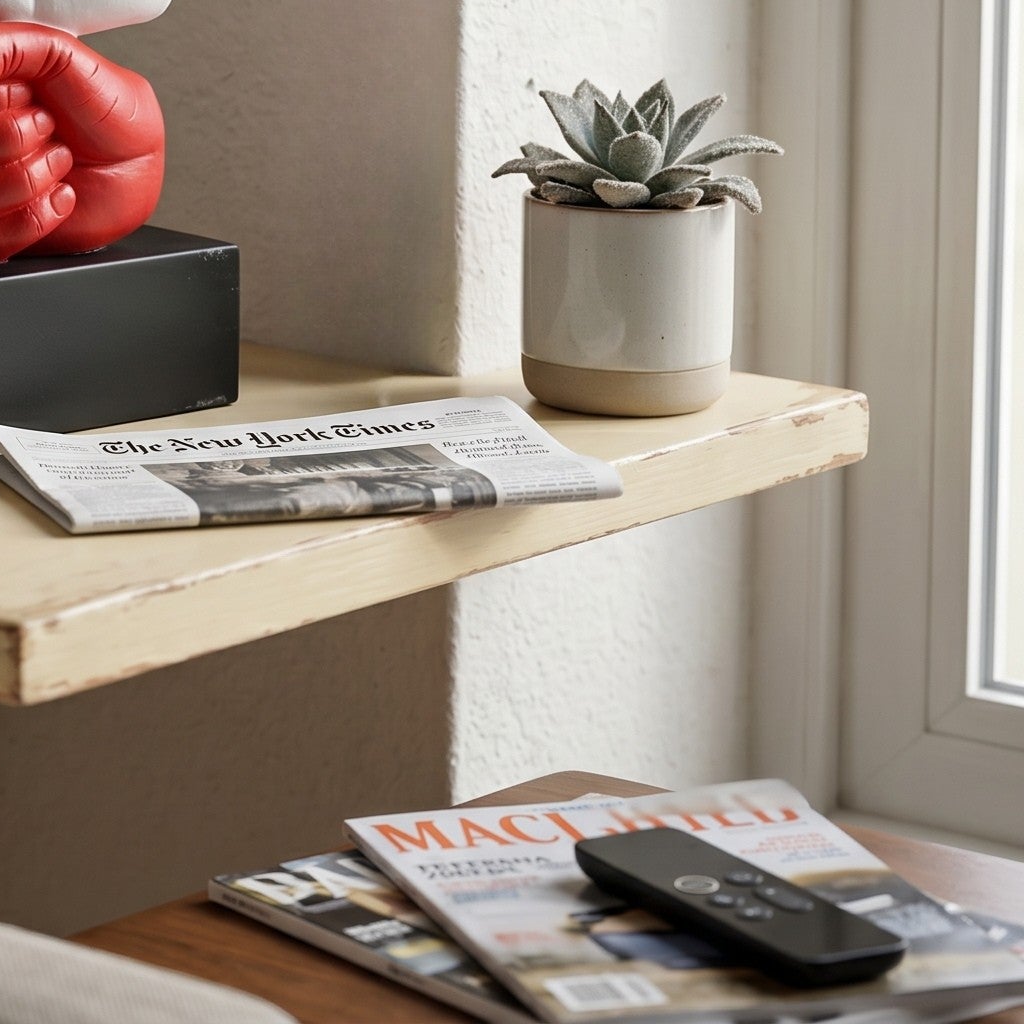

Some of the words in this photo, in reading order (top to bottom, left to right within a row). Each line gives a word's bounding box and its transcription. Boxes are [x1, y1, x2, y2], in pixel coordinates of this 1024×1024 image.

[99, 440, 164, 456] The
[167, 437, 242, 453] New
[246, 427, 329, 449] York
[330, 418, 436, 439] Times
